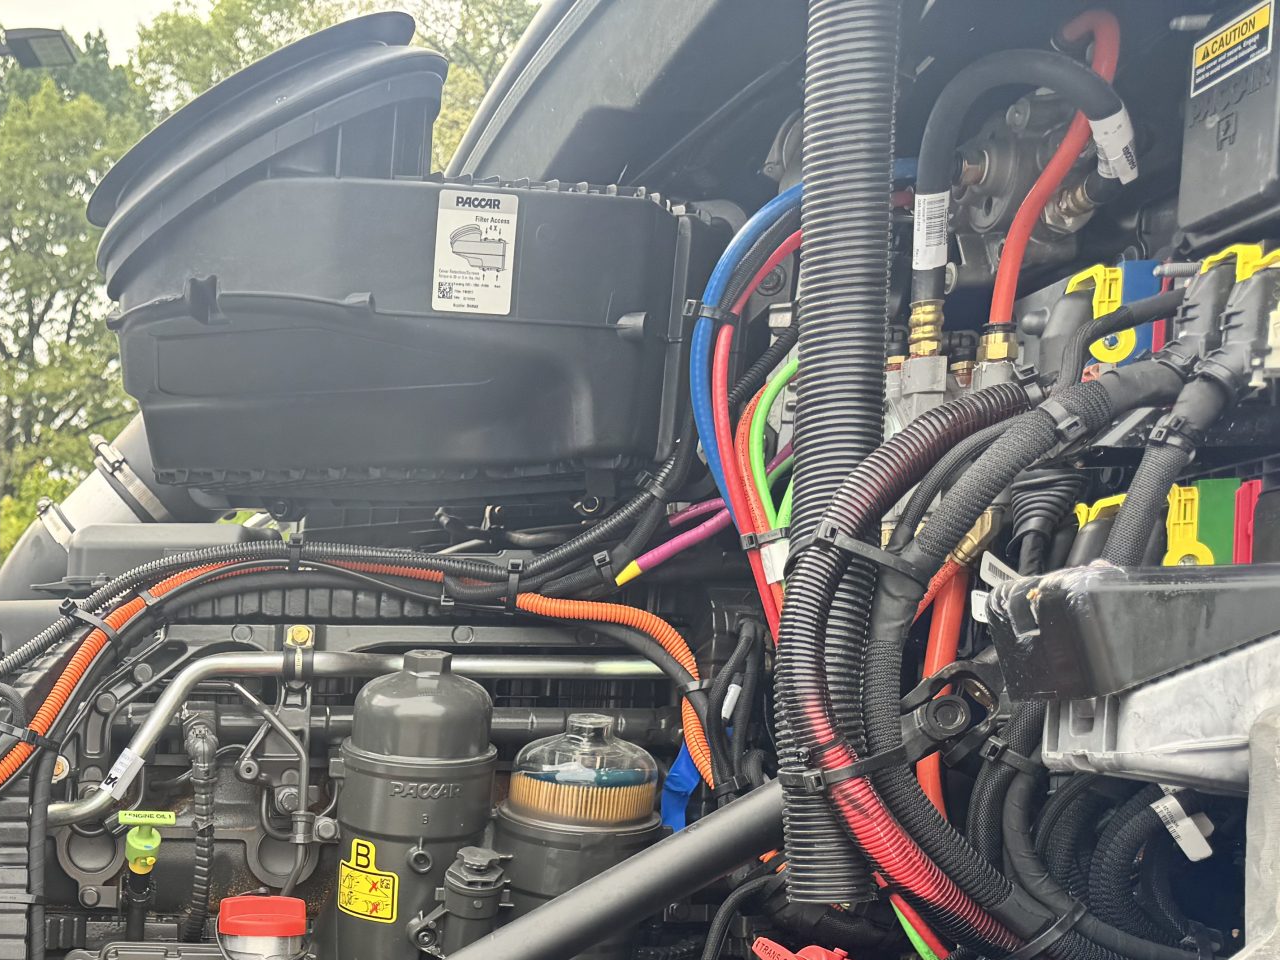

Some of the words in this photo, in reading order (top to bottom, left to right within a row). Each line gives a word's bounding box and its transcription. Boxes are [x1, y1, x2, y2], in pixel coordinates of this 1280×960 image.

[1211, 17, 1256, 55] CAUTION
[456, 196, 501, 210] PACCAR
[389, 782, 463, 799] PACCAR
[356, 842, 371, 869] B
